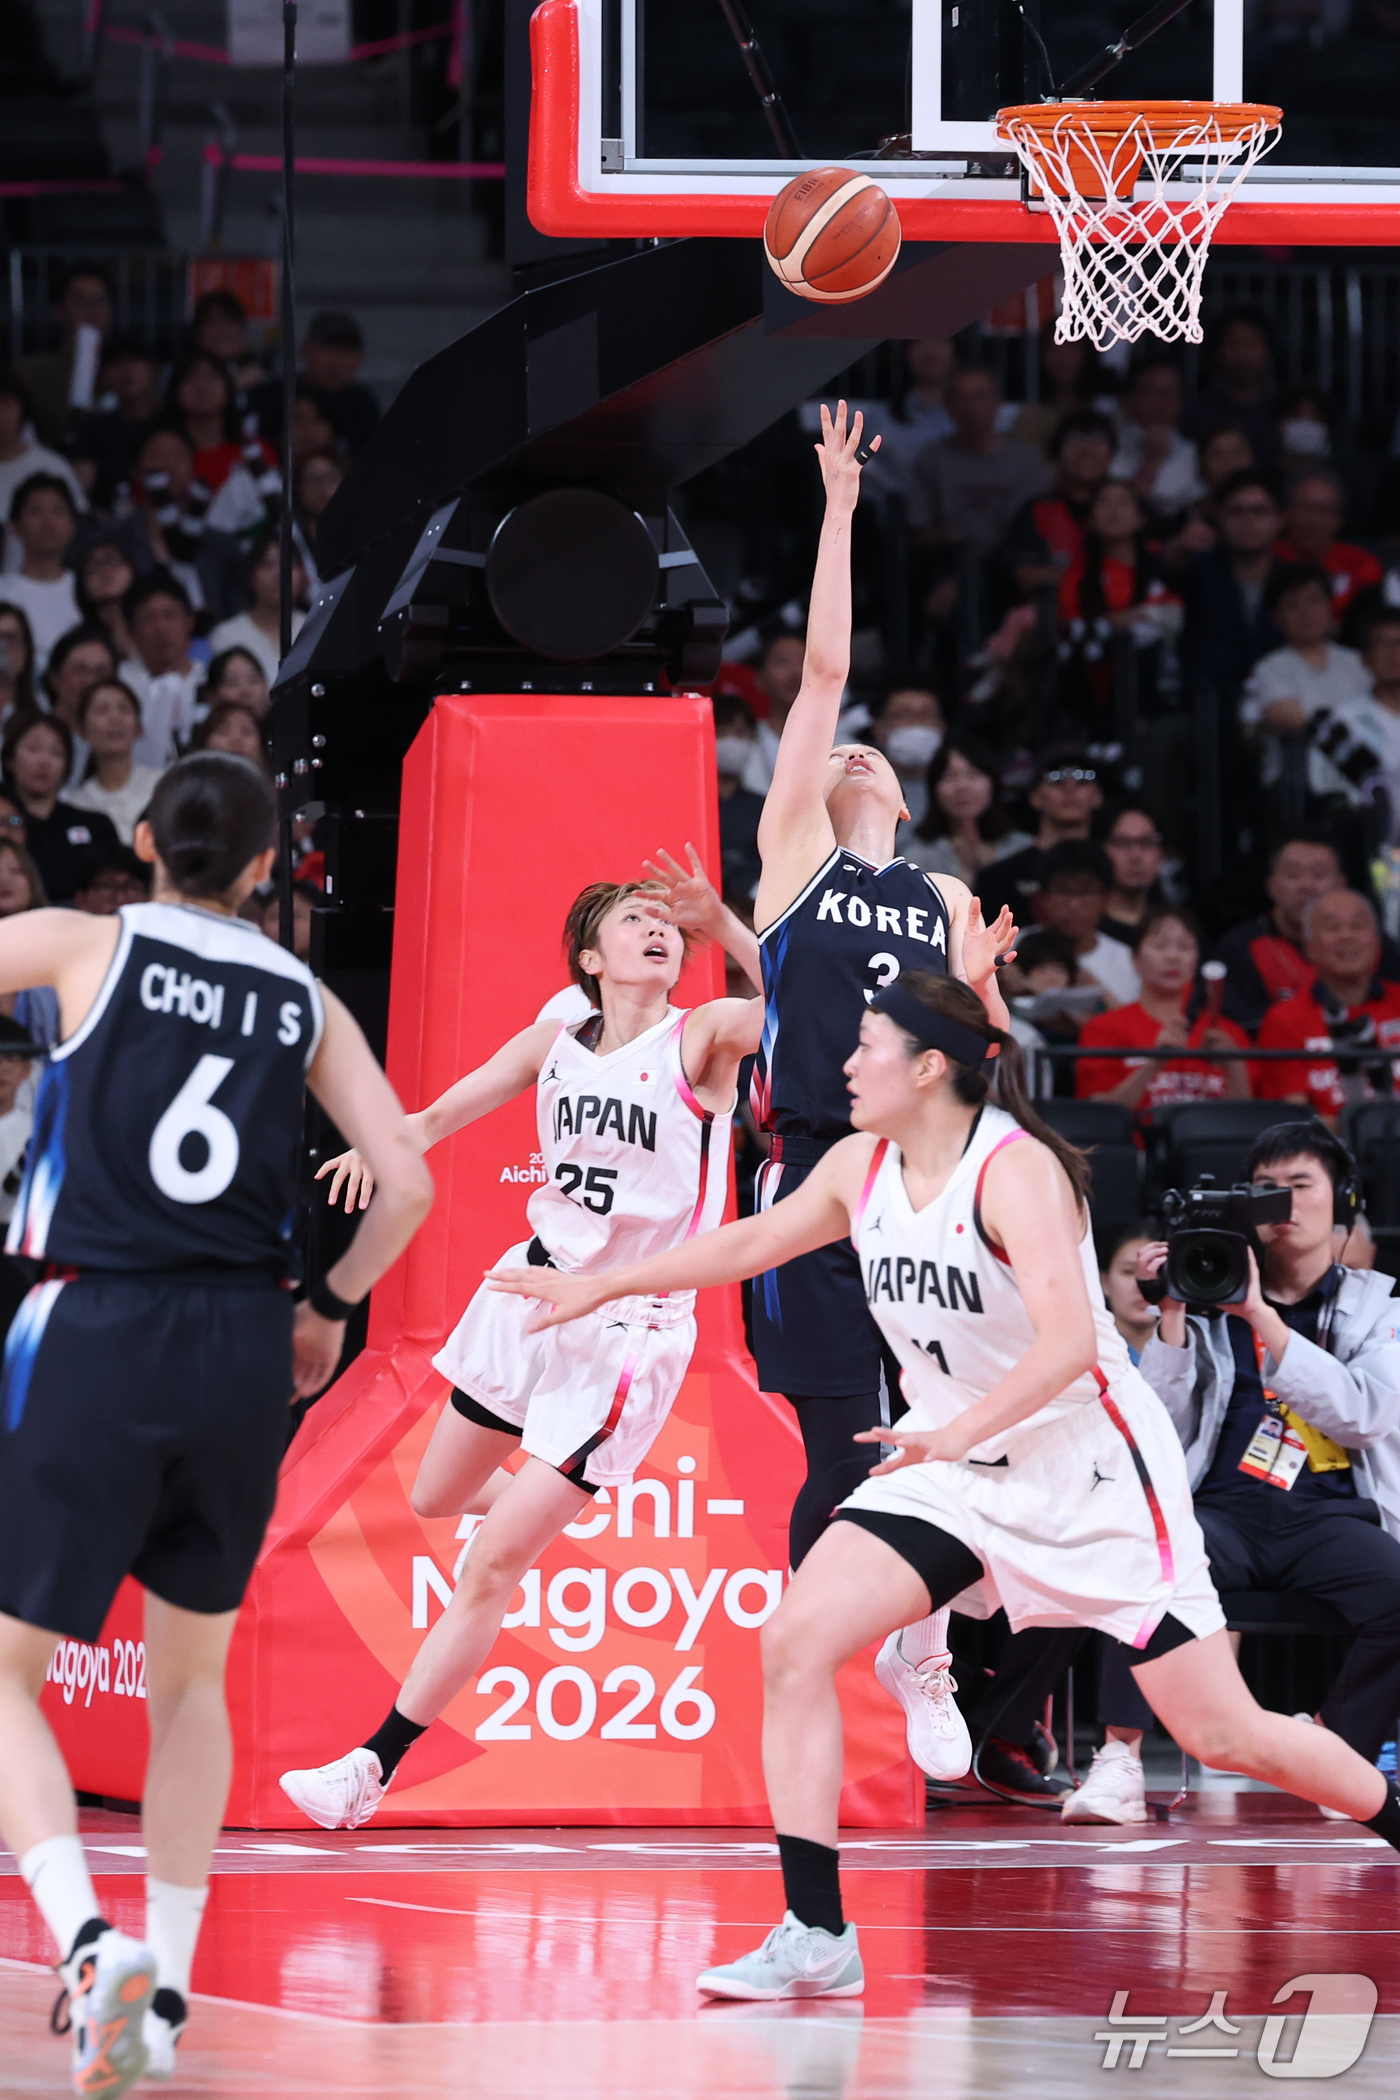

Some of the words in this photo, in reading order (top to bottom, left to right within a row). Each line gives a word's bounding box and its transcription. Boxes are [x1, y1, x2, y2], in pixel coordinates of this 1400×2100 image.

[794, 178, 820, 202] FIBA
[816, 888, 947, 956] KOREA
[140, 962, 226, 1030] CHOI
[241, 991, 258, 1037] I
[277, 1001, 303, 1046] S
[862, 952, 900, 1006] 3
[148, 1053, 240, 1205] 6
[499, 1165, 547, 1184] Aichi
[555, 1162, 619, 1216] 25
[911, 1338, 953, 1376] 1
[455, 1455, 745, 1539] chi-
[113, 1638, 149, 1699] 202
[474, 1664, 717, 1741] 2026
